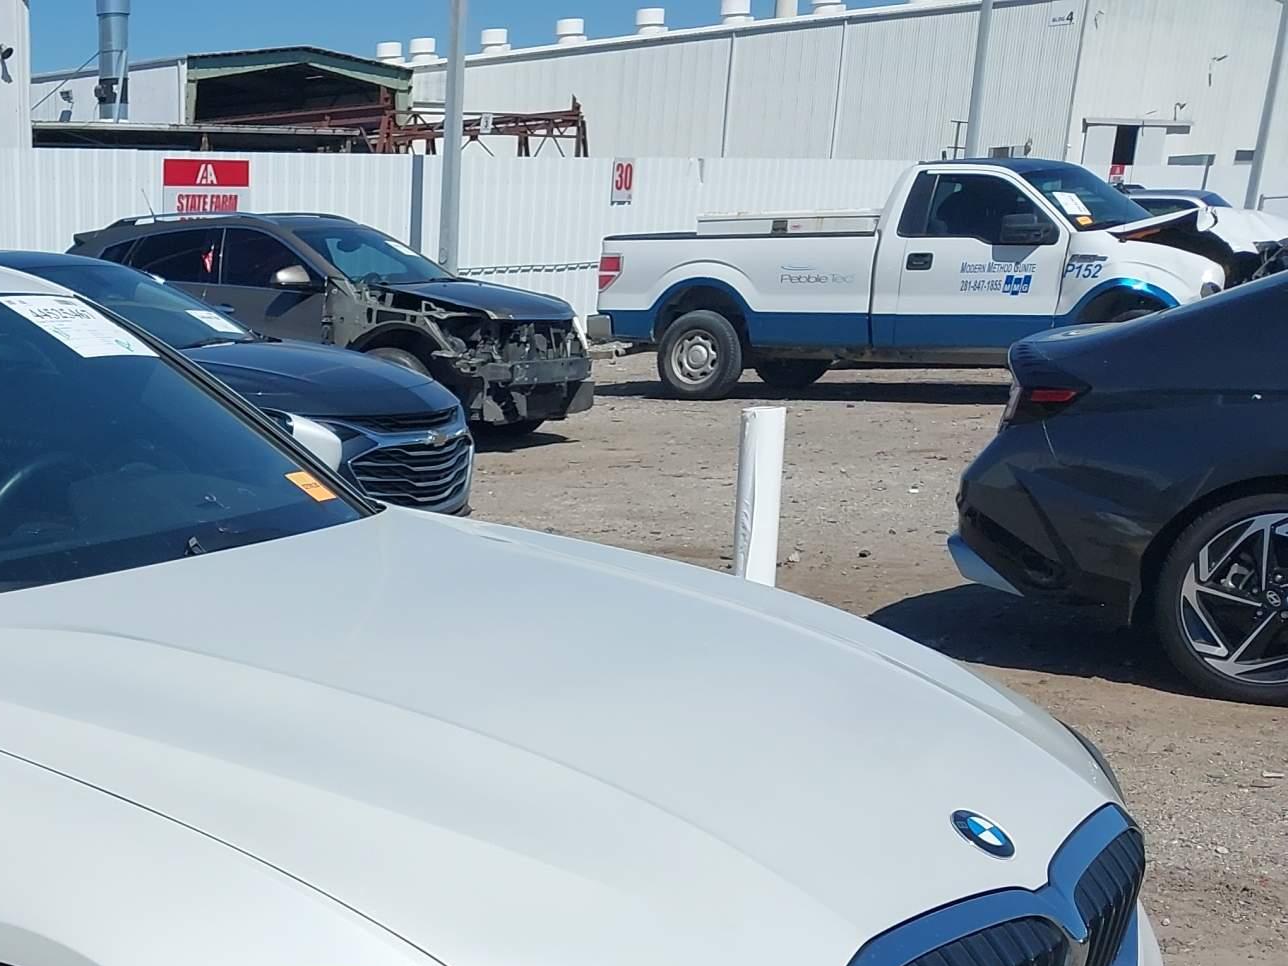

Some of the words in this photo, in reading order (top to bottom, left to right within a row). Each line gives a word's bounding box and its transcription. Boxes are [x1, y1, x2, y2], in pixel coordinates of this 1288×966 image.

[615, 162, 633, 191] 30
[176, 194, 208, 212] STATE
[210, 194, 238, 212] FARM
[960, 261, 986, 273] MODERN
[986, 261, 1013, 273] METHOD
[1013, 262, 1037, 273] GUNITE
[1063, 263, 1103, 278] P152
[780, 273, 829, 284] Pebble
